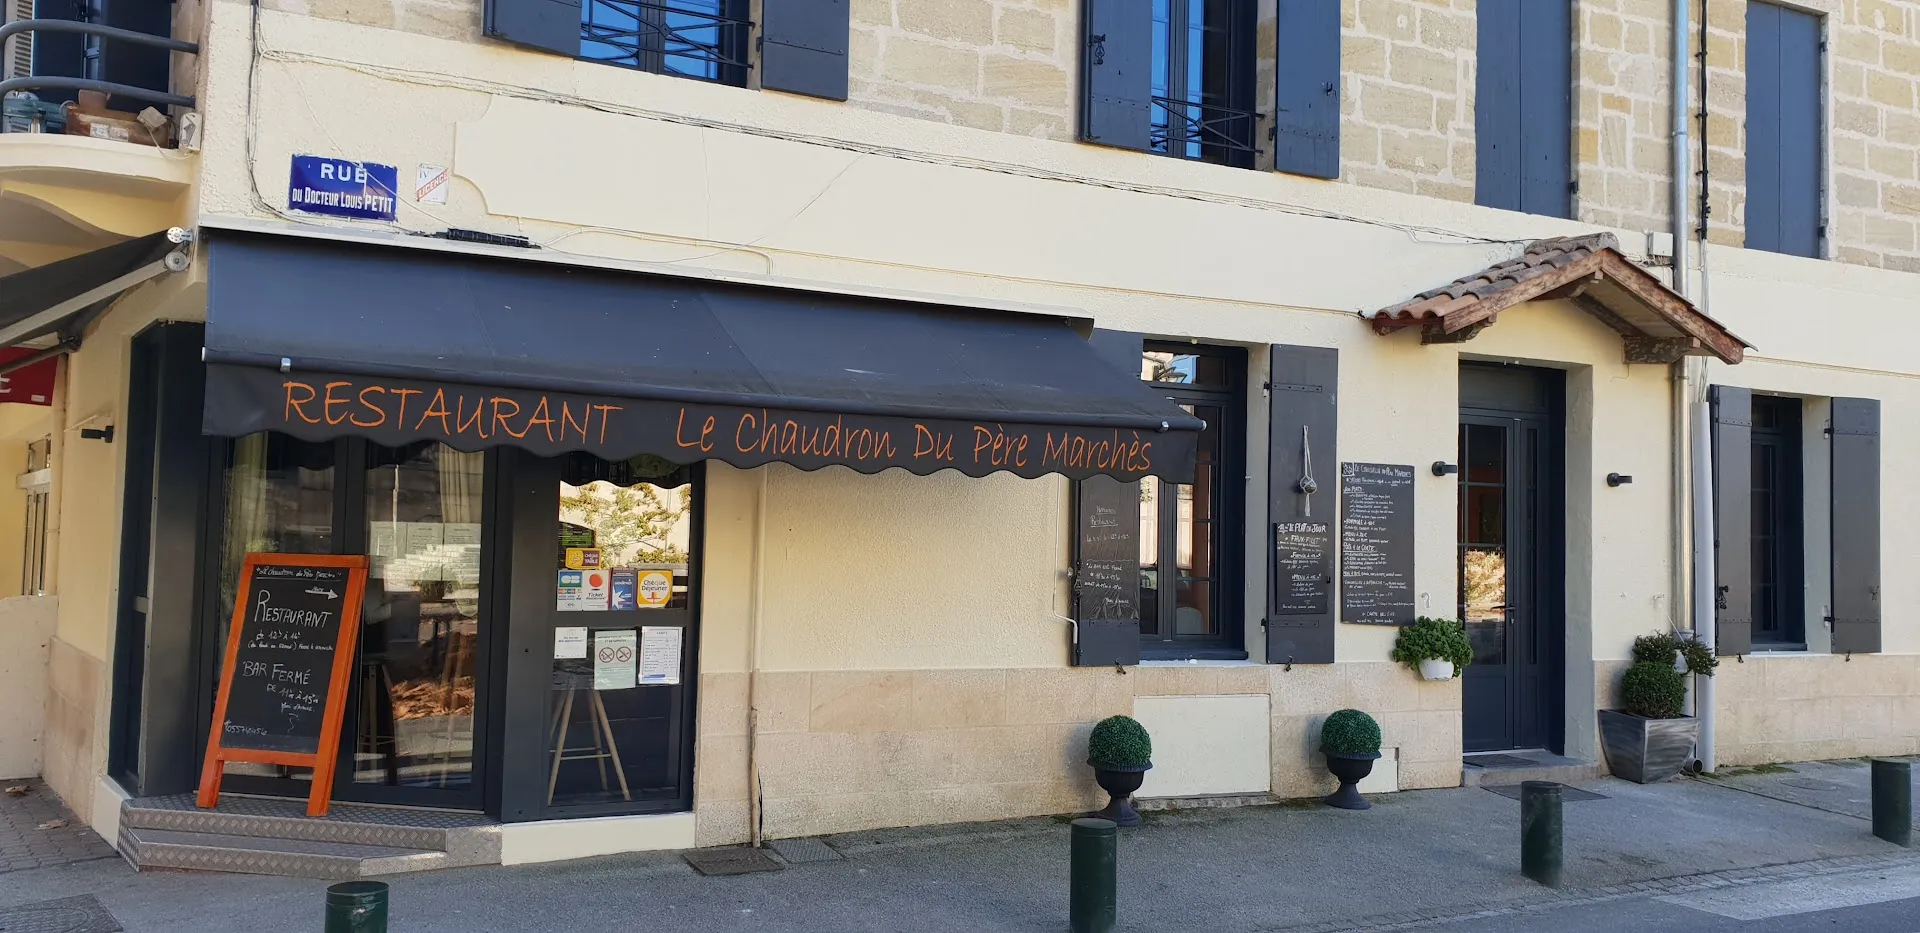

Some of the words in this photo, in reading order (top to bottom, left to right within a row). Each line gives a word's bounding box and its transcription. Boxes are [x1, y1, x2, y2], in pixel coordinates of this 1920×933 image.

[320, 163, 367, 183] RUE
[418, 171, 448, 198] LICENCE
[304, 186, 339, 207] DOCTEUR
[340, 191, 362, 210] LOUIS
[365, 194, 394, 213] PETIT
[282, 381, 624, 445] RESTAURANT
[675, 407, 715, 452] Le
[735, 408, 896, 461] Chaudron
[914, 423, 953, 462] Du
[973, 425, 1029, 468] Père
[1042, 429, 1153, 472] Marchès
[1312, 524, 1327, 533] JOUR
[644, 579, 666, 587] Chèque
[254, 589, 332, 628] RESTAURANT
[242, 660, 267, 677] BAR
[271, 663, 311, 685] FERMÉ
